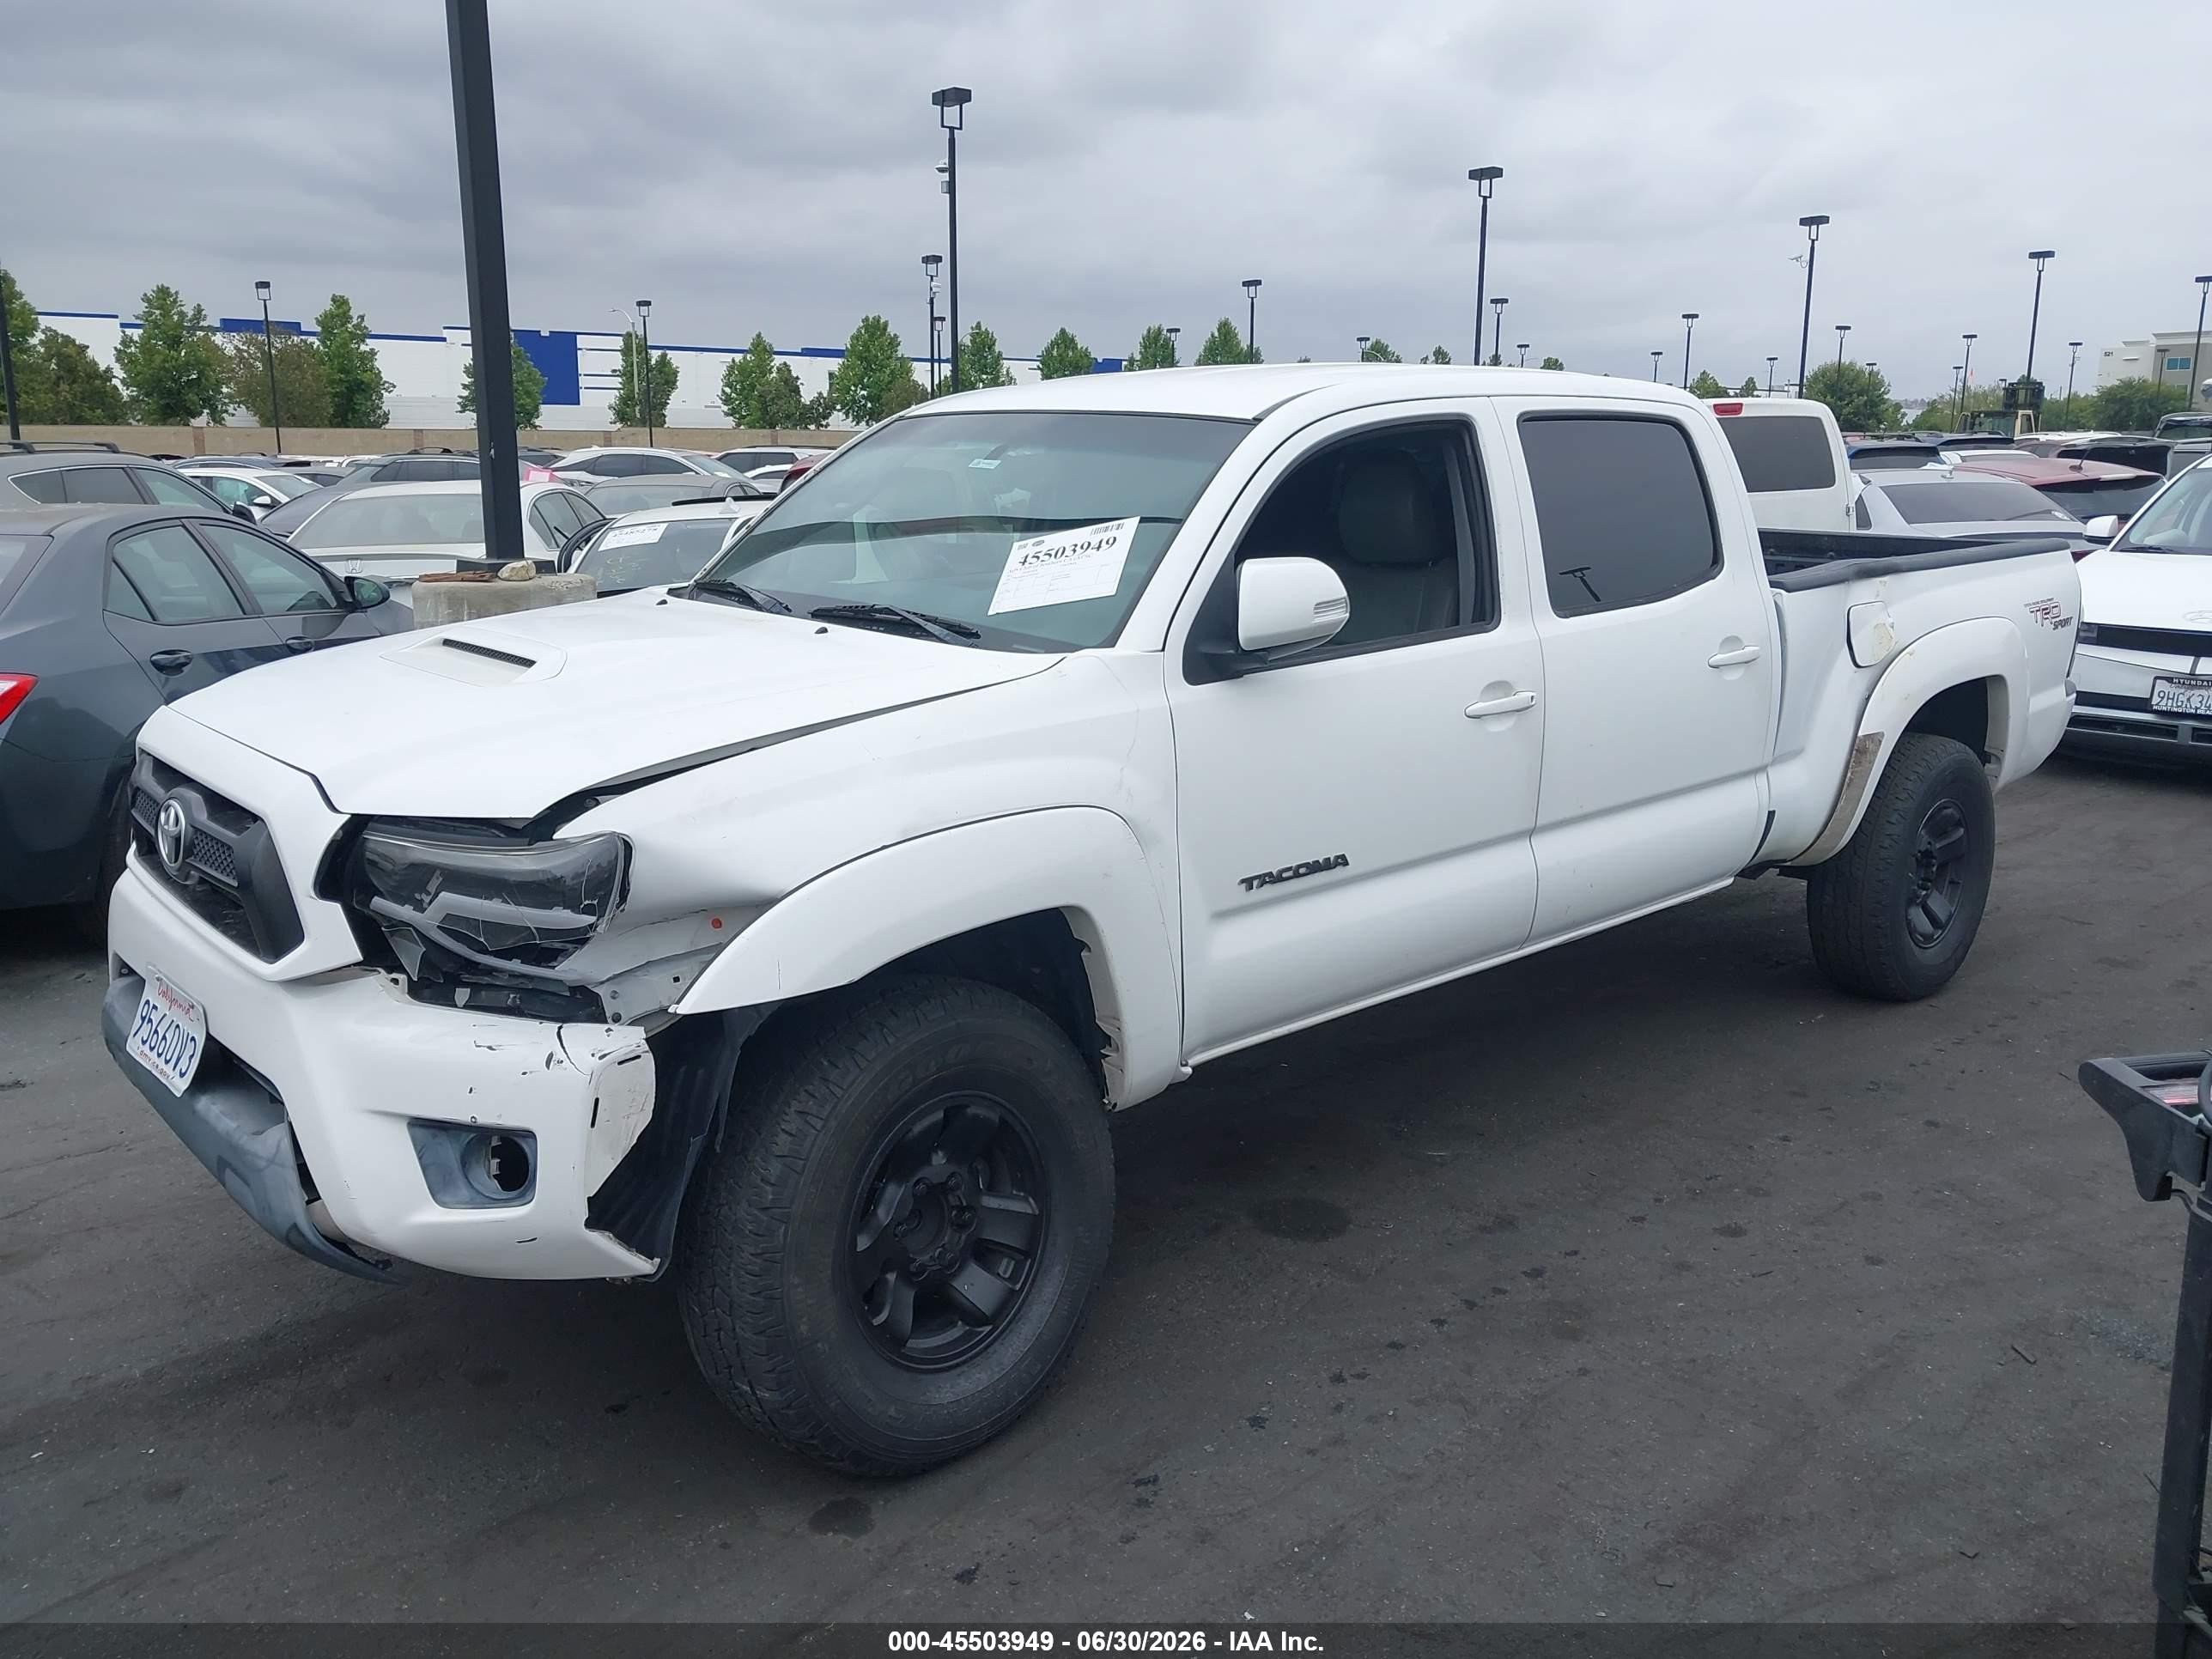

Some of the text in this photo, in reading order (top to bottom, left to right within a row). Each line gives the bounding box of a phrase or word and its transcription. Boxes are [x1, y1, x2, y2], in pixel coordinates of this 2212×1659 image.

[1018, 536, 1117, 567] 45503949
[2029, 601, 2062, 627] TRD
[2052, 616, 2074, 631] SPORT
[2172, 678, 2212, 686] HYUNDAI
[2153, 705, 2195, 714] HUNTINGTON
[1237, 853, 1350, 892] TACOMA
[133, 998, 198, 1079] 95660V3
